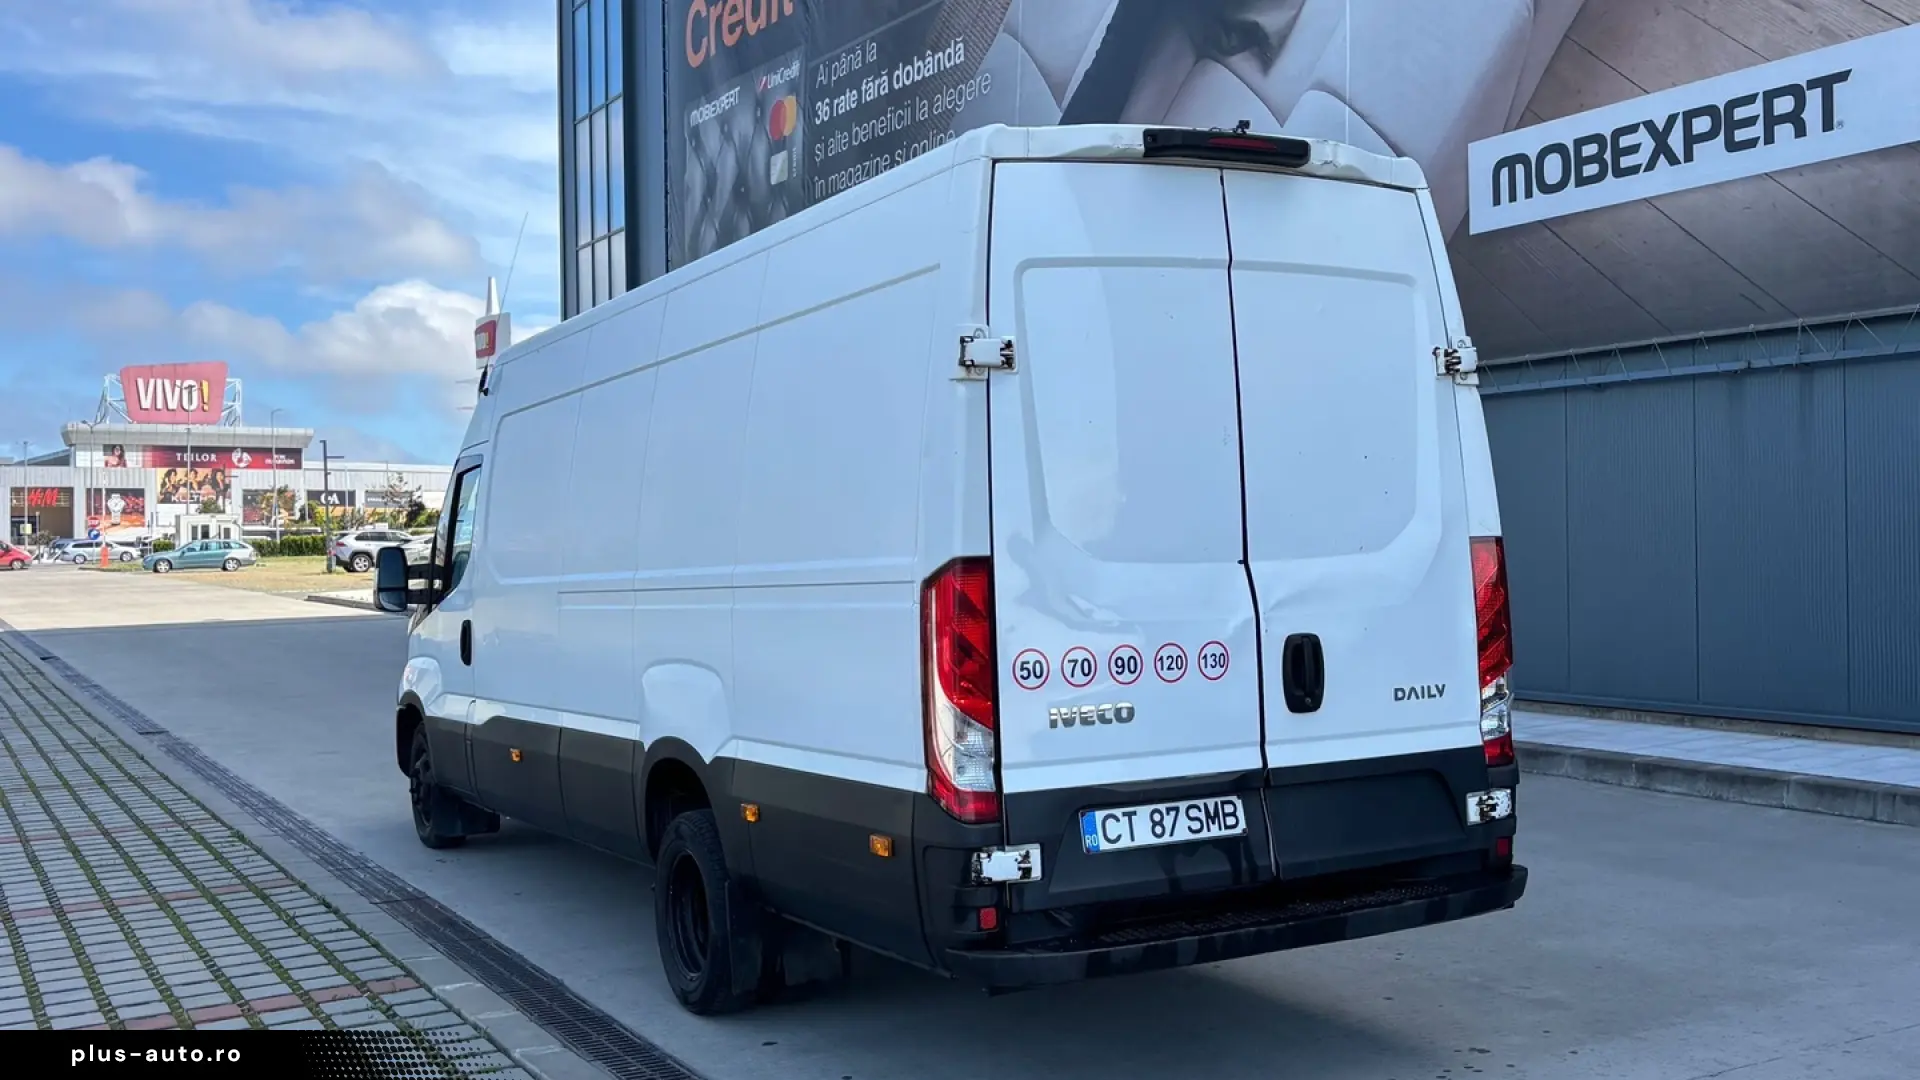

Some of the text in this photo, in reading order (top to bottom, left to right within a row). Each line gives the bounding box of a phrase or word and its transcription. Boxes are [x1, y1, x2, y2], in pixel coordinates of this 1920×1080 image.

[686, 0, 794, 68] Cred
[767, 60, 801, 89] UniCredit
[815, 36, 965, 125] 36 rate fără dobândă
[816, 40, 877, 88] Ai până la
[690, 86, 741, 127] MOBEXPERT
[815, 136, 825, 169] și
[828, 131, 849, 158] alte
[852, 99, 912, 146] beneficii
[916, 96, 929, 122] la
[933, 72, 992, 113] alegere
[1492, 68, 1853, 207] MOBEXPERT
[815, 175, 826, 200] în
[828, 153, 891, 194] magazine
[136, 377, 209, 412] VIVO!
[1019, 659, 1044, 681] 50
[1067, 657, 1092, 678] 70
[1114, 655, 1138, 676] 90
[1157, 654, 1184, 671] 120
[1201, 652, 1226, 669] 130
[1394, 683, 1446, 701] DAILY
[1049, 702, 1135, 729] IVECO
[1085, 799, 1240, 848] RO CT 87 SMB
